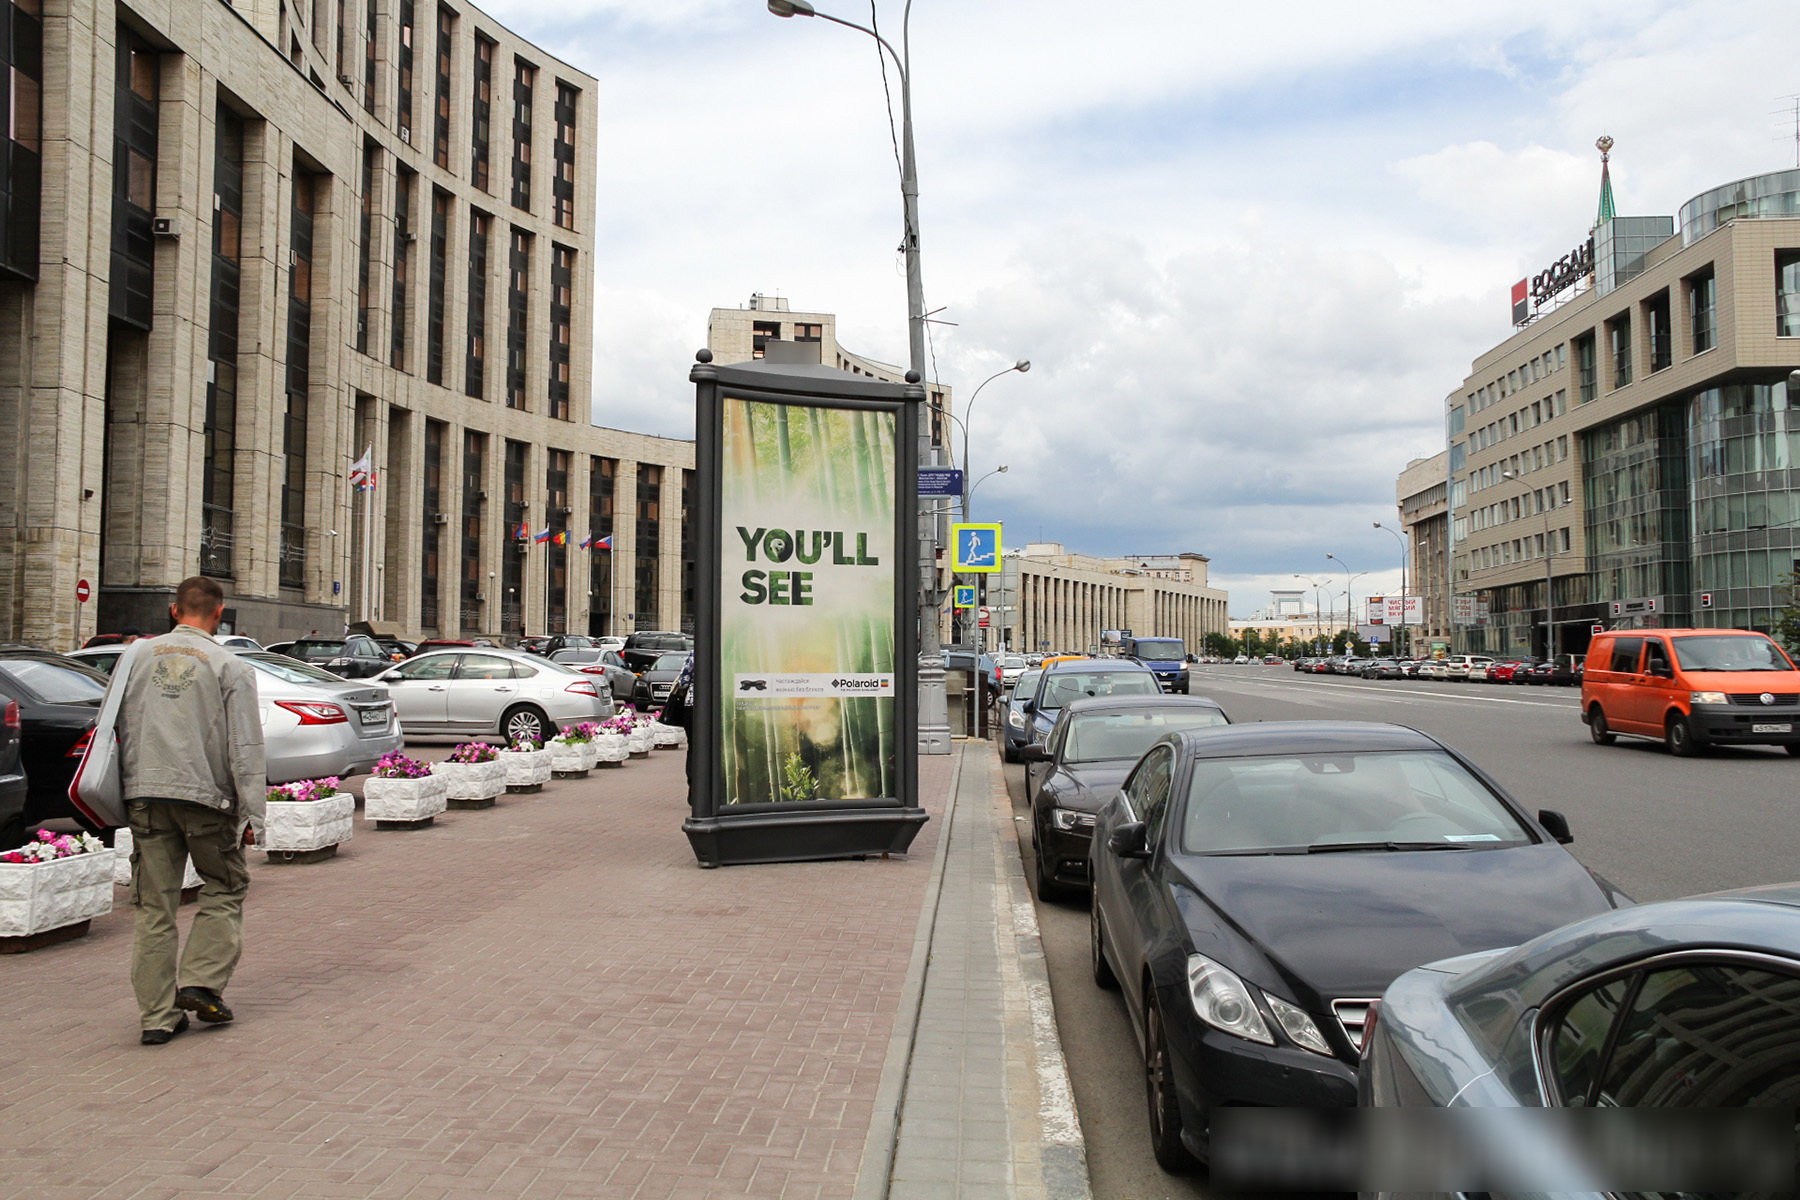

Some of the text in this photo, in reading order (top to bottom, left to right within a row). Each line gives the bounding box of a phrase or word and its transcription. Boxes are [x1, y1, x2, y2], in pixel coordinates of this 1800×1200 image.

[736, 526, 879, 566] YOU'LL
[740, 569, 814, 605] SEE
[840, 679, 879, 688] Polaroid
